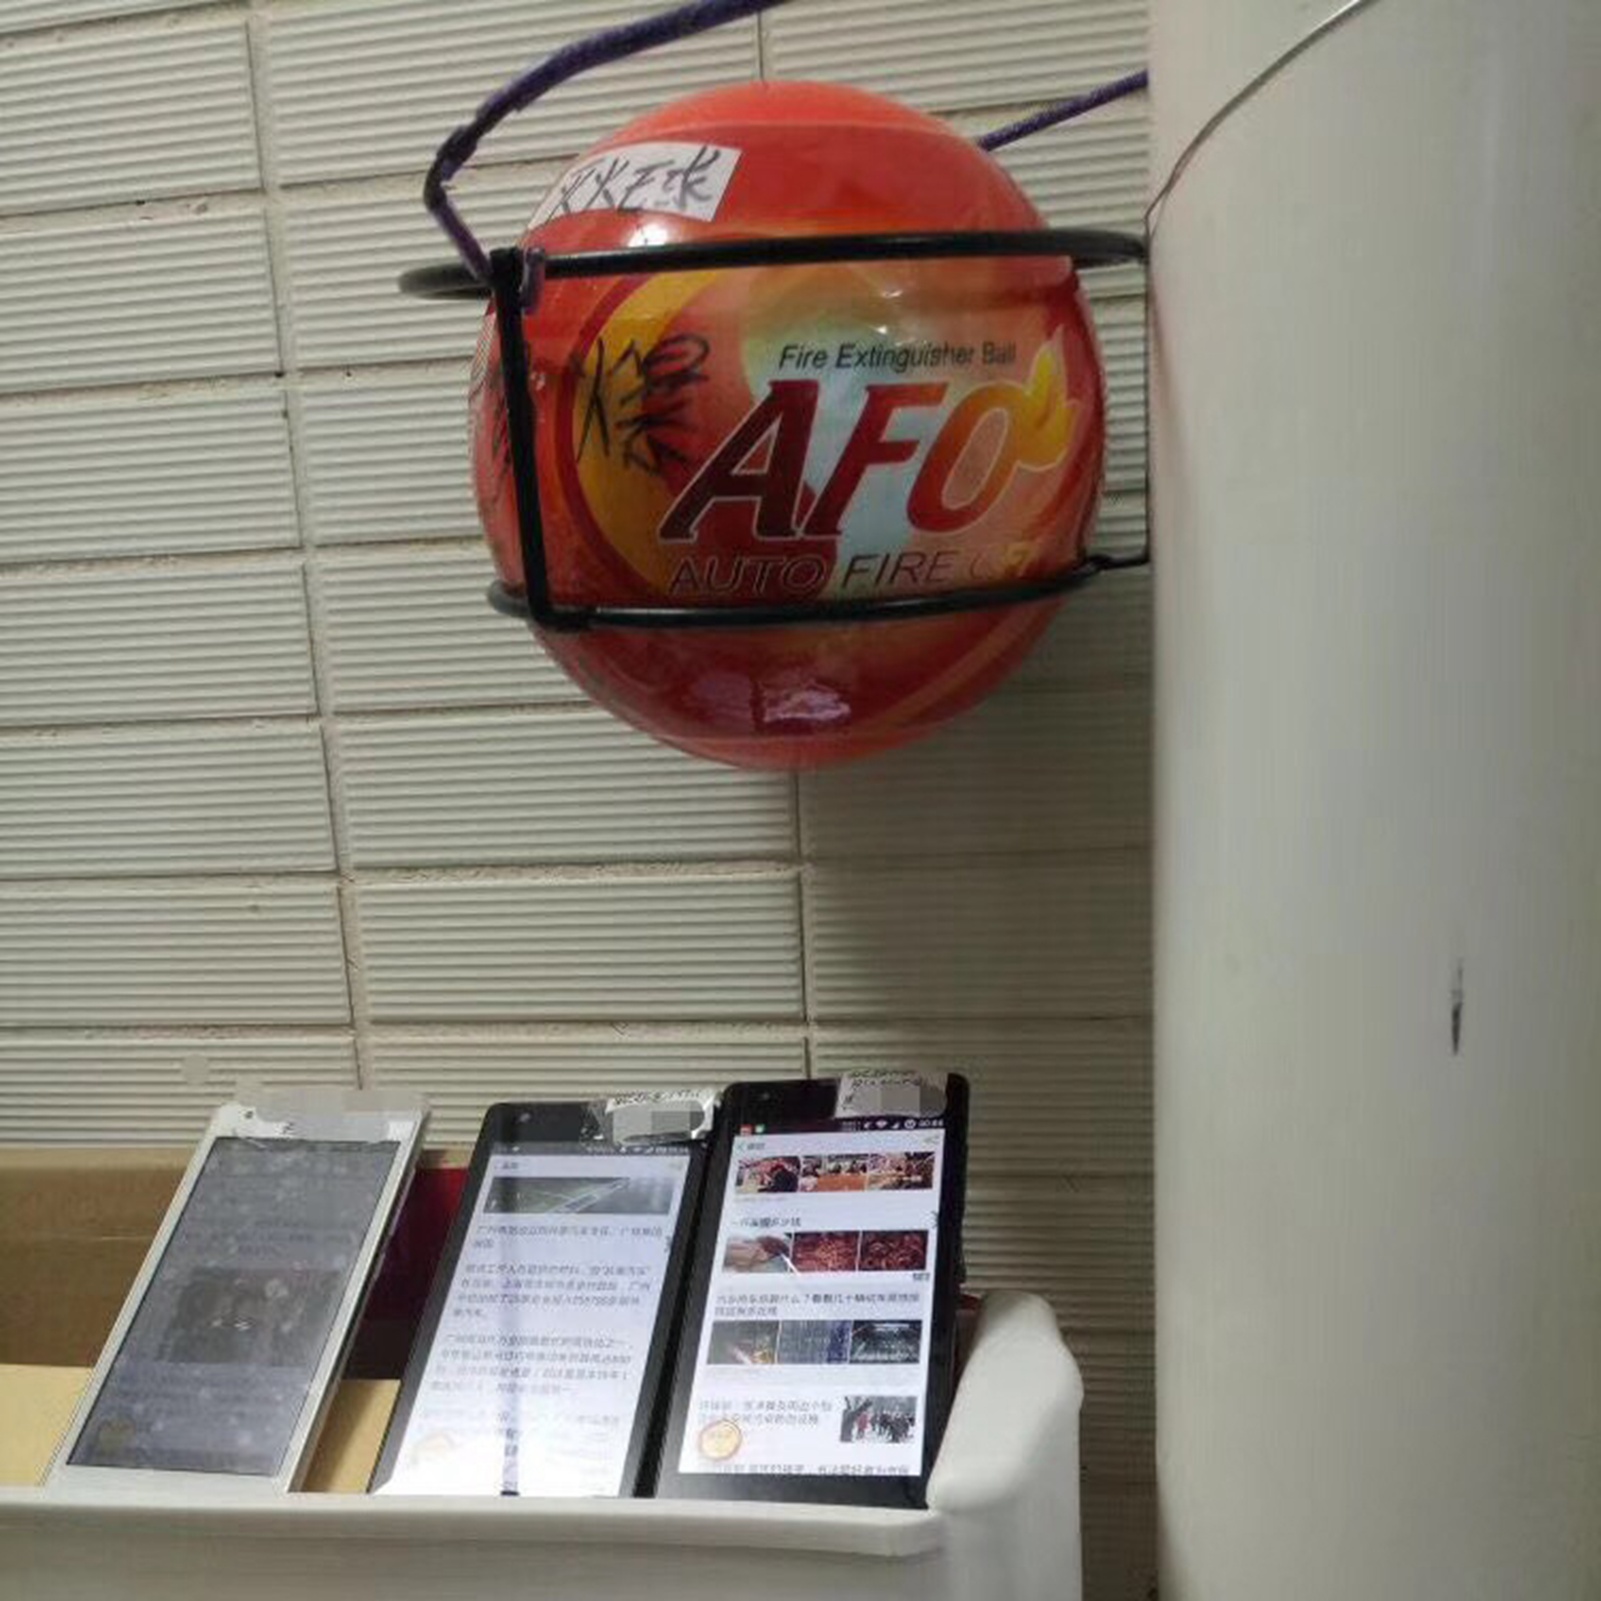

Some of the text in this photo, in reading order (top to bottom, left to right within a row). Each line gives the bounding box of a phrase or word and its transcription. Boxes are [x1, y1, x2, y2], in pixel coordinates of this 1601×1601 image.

[778, 340, 1017, 374] Fire Extinguisher Ball
[657, 377, 1040, 544] AFO
[669, 553, 828, 596] AUTO
[841, 548, 961, 591] FIRE
